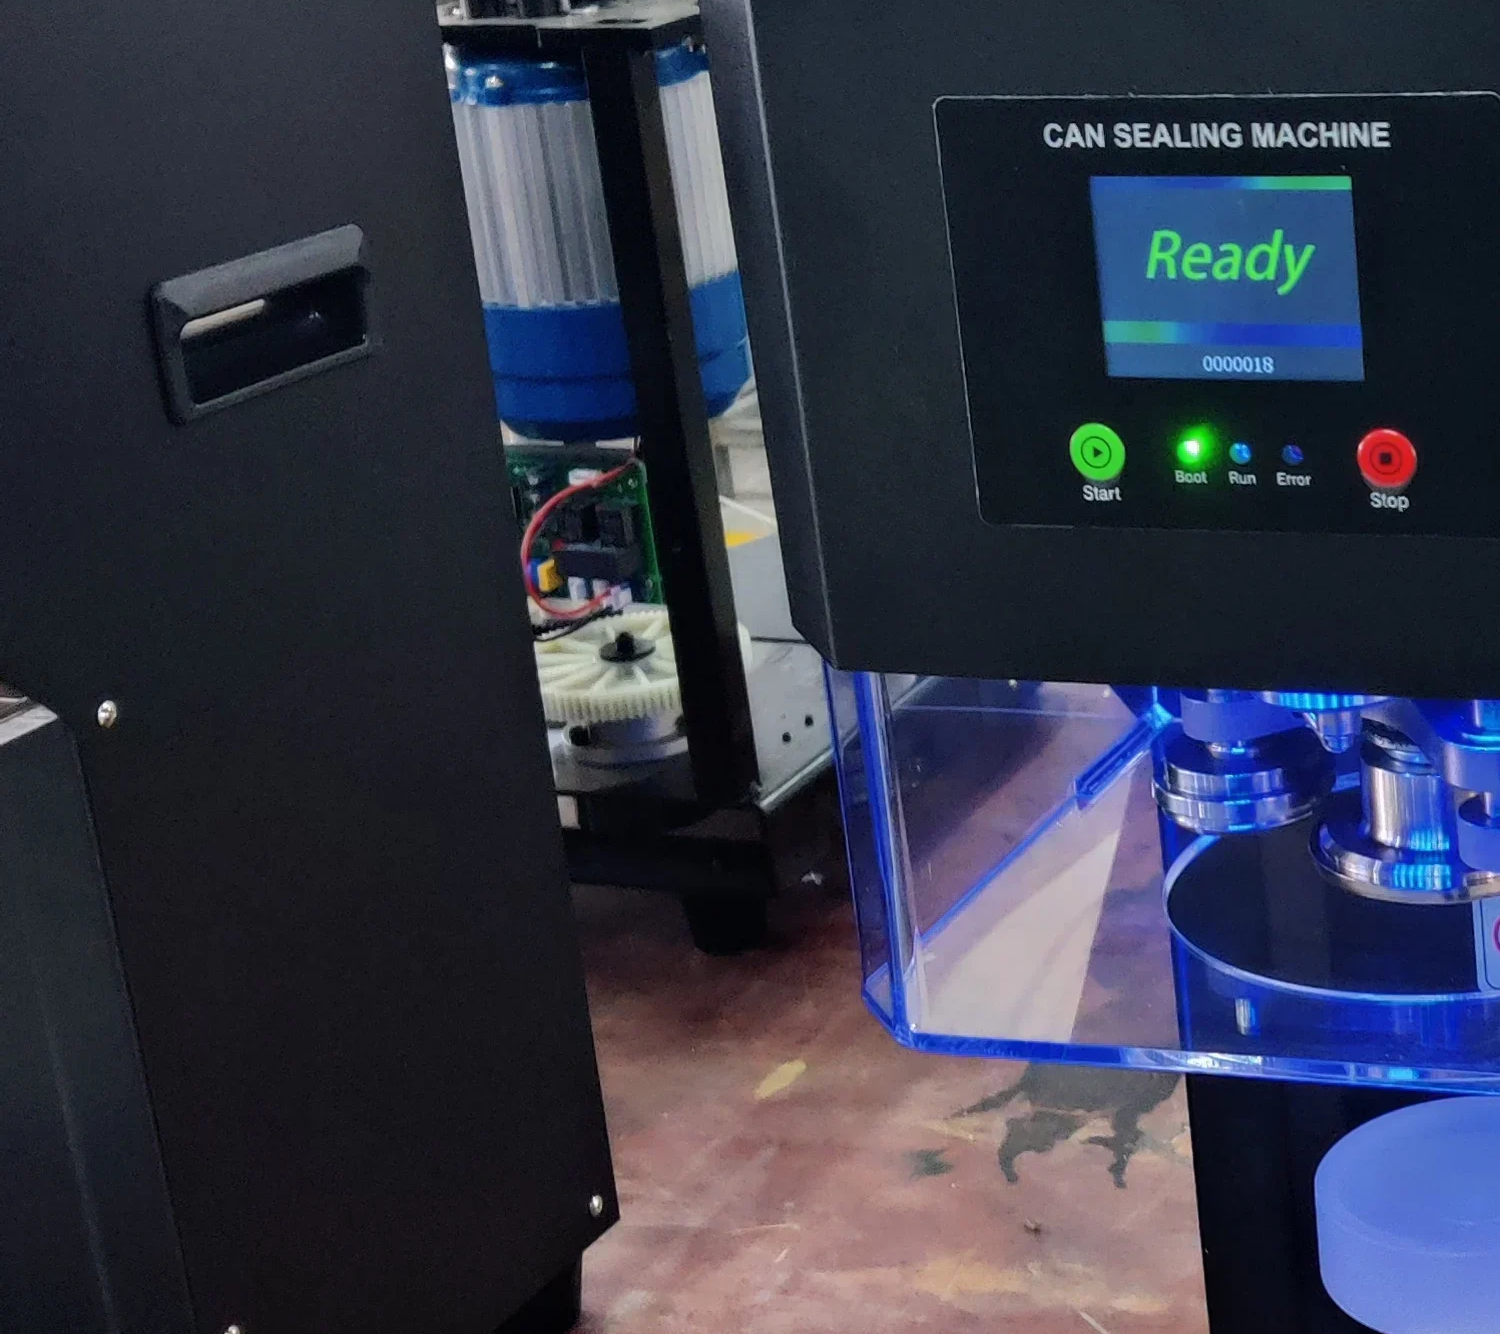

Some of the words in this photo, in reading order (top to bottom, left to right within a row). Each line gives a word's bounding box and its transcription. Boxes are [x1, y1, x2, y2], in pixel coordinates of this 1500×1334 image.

[1043, 122, 1106, 148] CAN
[1113, 122, 1244, 148] SEALING
[1250, 121, 1391, 148] MACHINE
[1146, 229, 1316, 295] Ready
[1202, 355, 1275, 373] 0000018
[1174, 469, 1208, 484] Boot
[1228, 470, 1257, 485] Run
[1276, 471, 1312, 486] Error
[1082, 484, 1122, 501] Start
[1369, 491, 1410, 512] Stop
